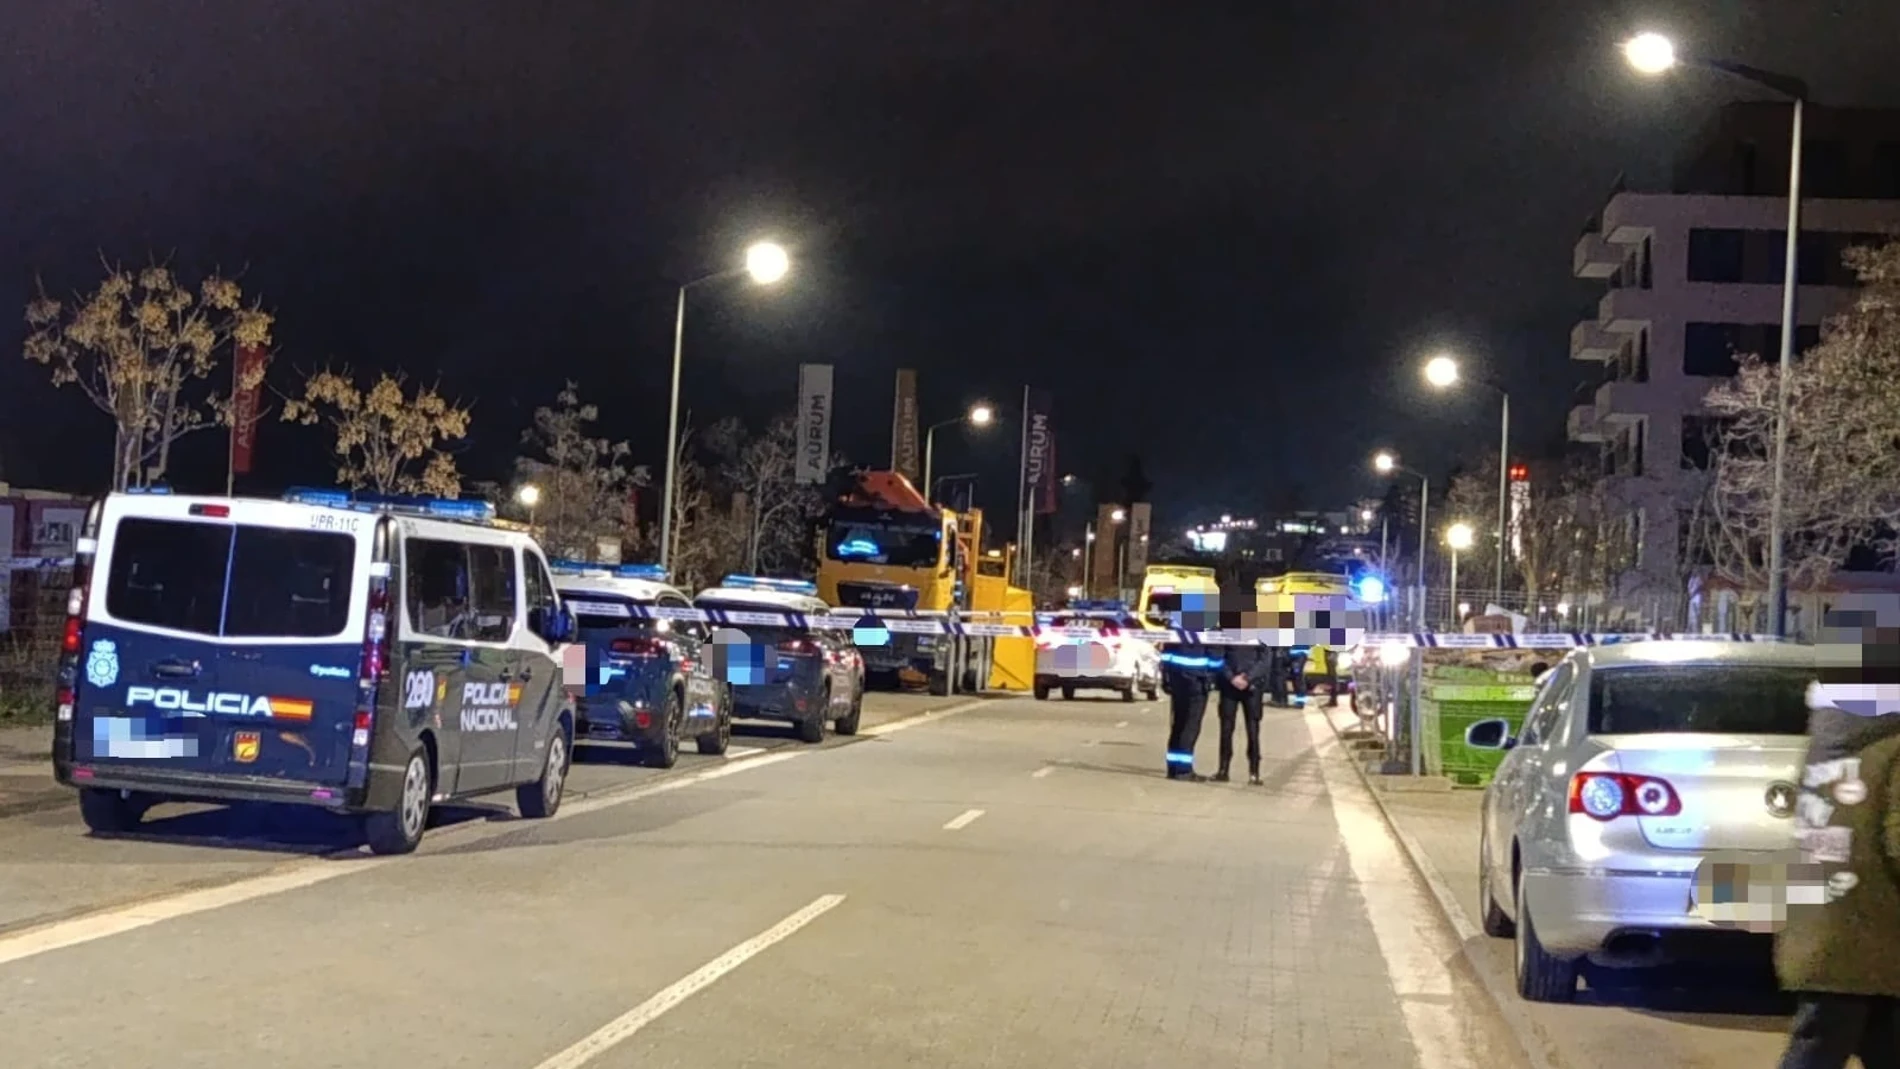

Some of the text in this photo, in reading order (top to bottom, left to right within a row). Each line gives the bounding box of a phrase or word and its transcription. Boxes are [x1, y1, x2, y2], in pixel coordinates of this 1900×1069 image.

[238, 388, 252, 449] AURU
[807, 394, 826, 470] AURUM
[1027, 413, 1048, 484] AURUM
[126, 686, 273, 717] POLICIA
[461, 682, 510, 705] POLICIA
[461, 708, 518, 732] NACIONAL
